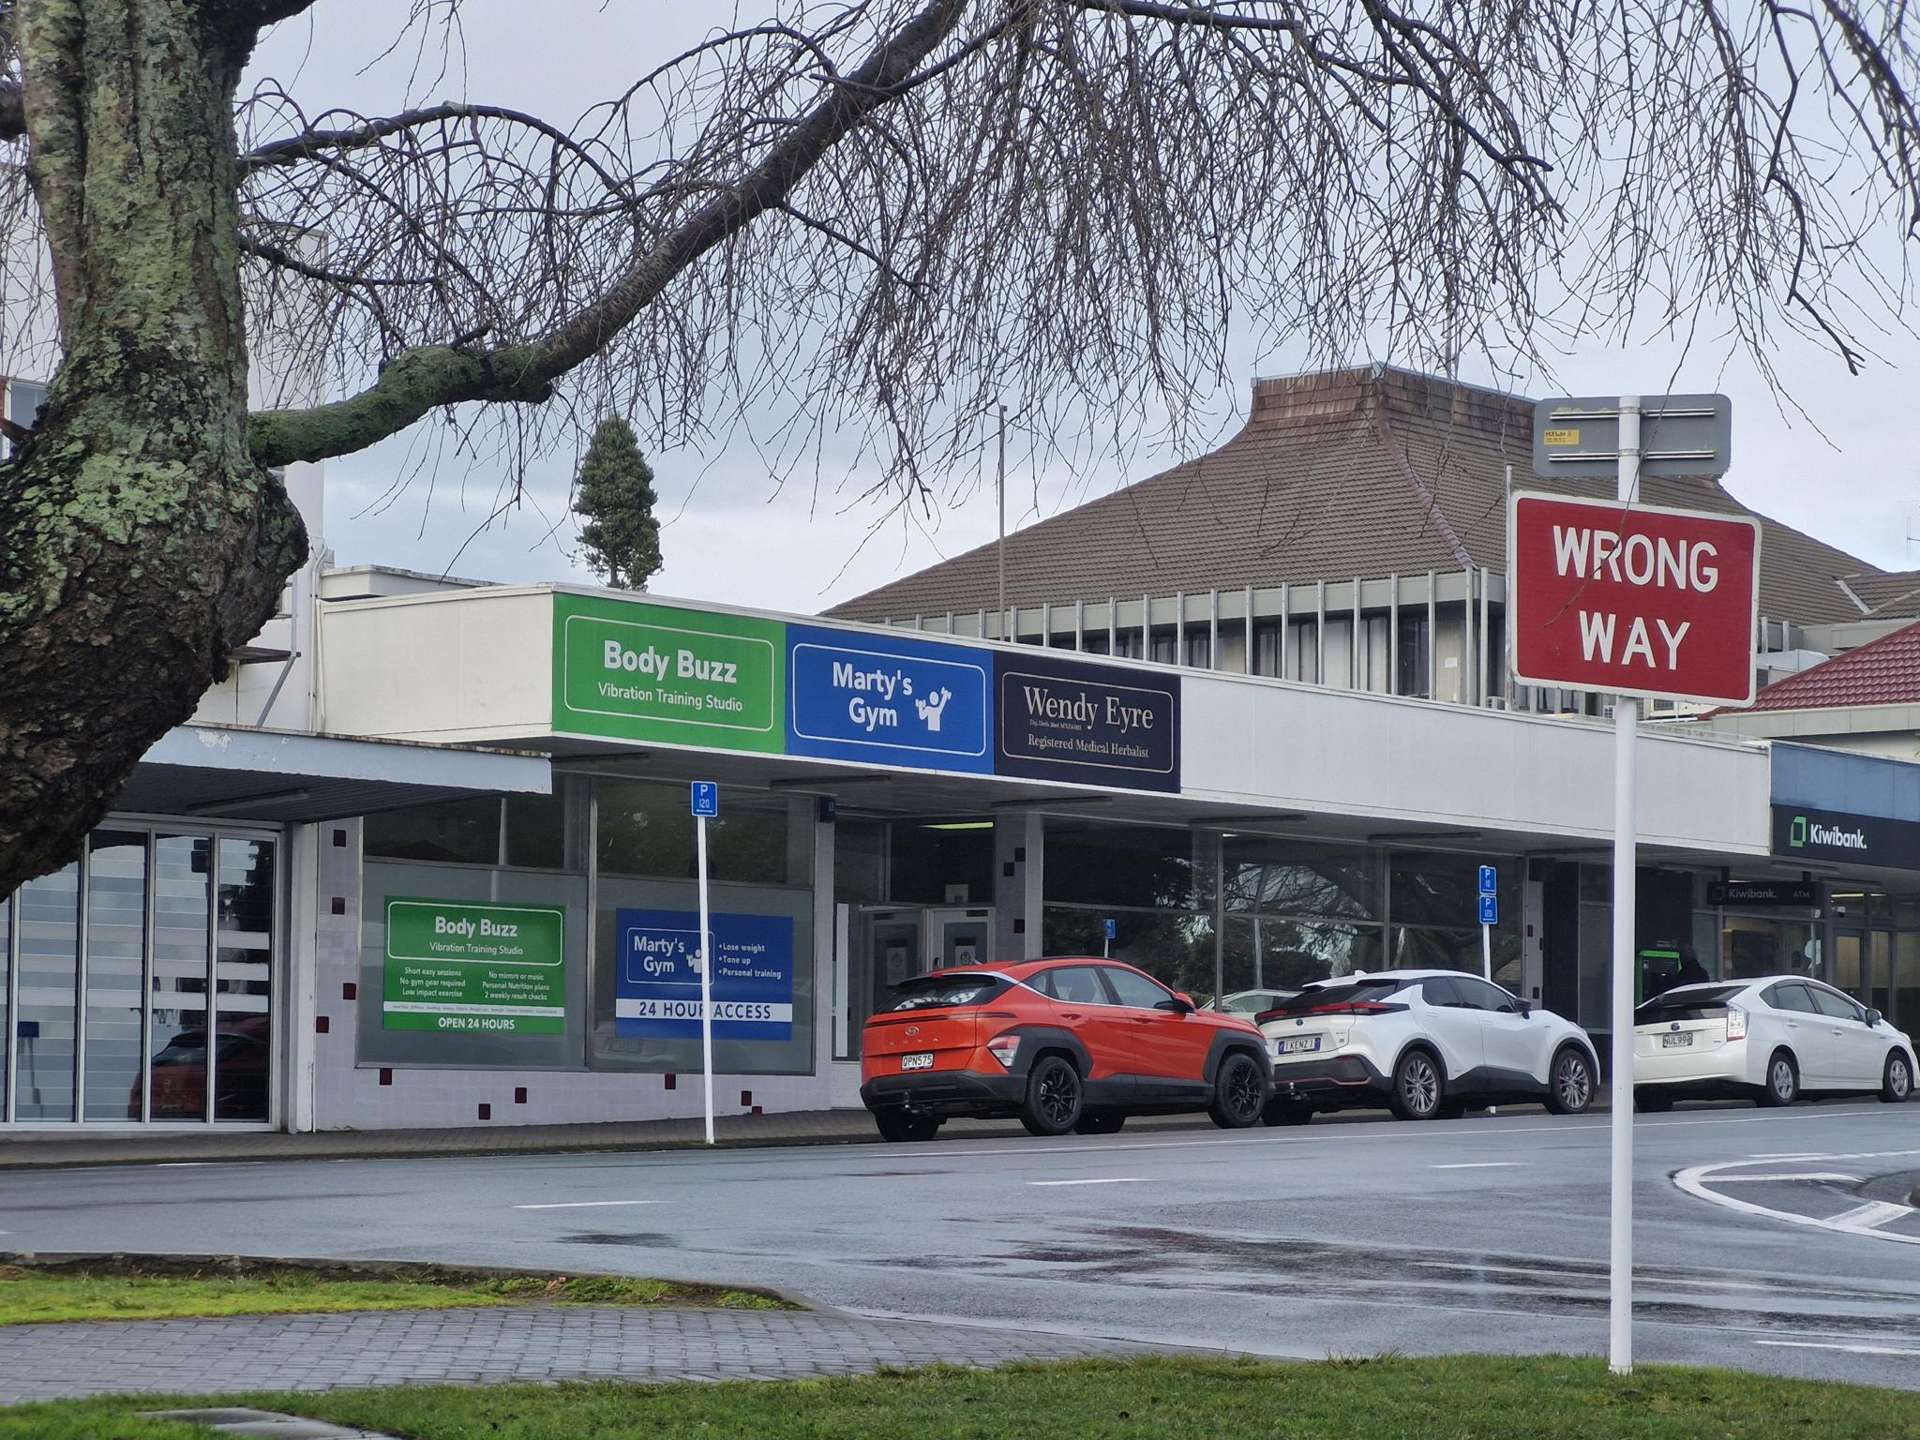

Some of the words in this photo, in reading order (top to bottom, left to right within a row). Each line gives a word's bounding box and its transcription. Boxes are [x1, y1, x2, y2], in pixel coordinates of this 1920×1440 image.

[1553, 525, 1718, 593] WRONG
[1579, 610, 1690, 670] WAY
[604, 639, 670, 681] Body
[677, 650, 737, 683] Buzz
[832, 661, 912, 701] Marty's
[598, 682, 652, 701] Vibration
[657, 689, 702, 710] Training
[706, 694, 743, 712] Studio
[849, 697, 897, 732] Gym
[1023, 686, 1098, 730] Wendy
[1105, 696, 1154, 733] Eyre
[1028, 733, 1074, 750] Registered
[1076, 740, 1109, 754] Medical
[1111, 743, 1149, 758] Herbalist
[700, 784, 708, 797] P
[435, 916, 475, 938] Body
[480, 919, 518, 937] Buzz
[429, 942, 465, 953] Vibration
[466, 944, 497, 956] Training
[499, 945, 523, 955] Studio
[634, 936, 685, 957] Marty's
[723, 943, 740, 951] Lose
[643, 957, 675, 976] Gym
[723, 956, 740, 964] Tone
[741, 957, 751, 967] up
[400, 977, 409, 985] No
[723, 968, 753, 977] Personal
[754, 968, 781, 980] training
[639, 1002, 656, 1016] 24
[714, 1004, 771, 1019] ACCESS
[438, 1017, 465, 1029] OPEN
[467, 1018, 479, 1028] 24
[482, 1018, 515, 1030] HOURS
